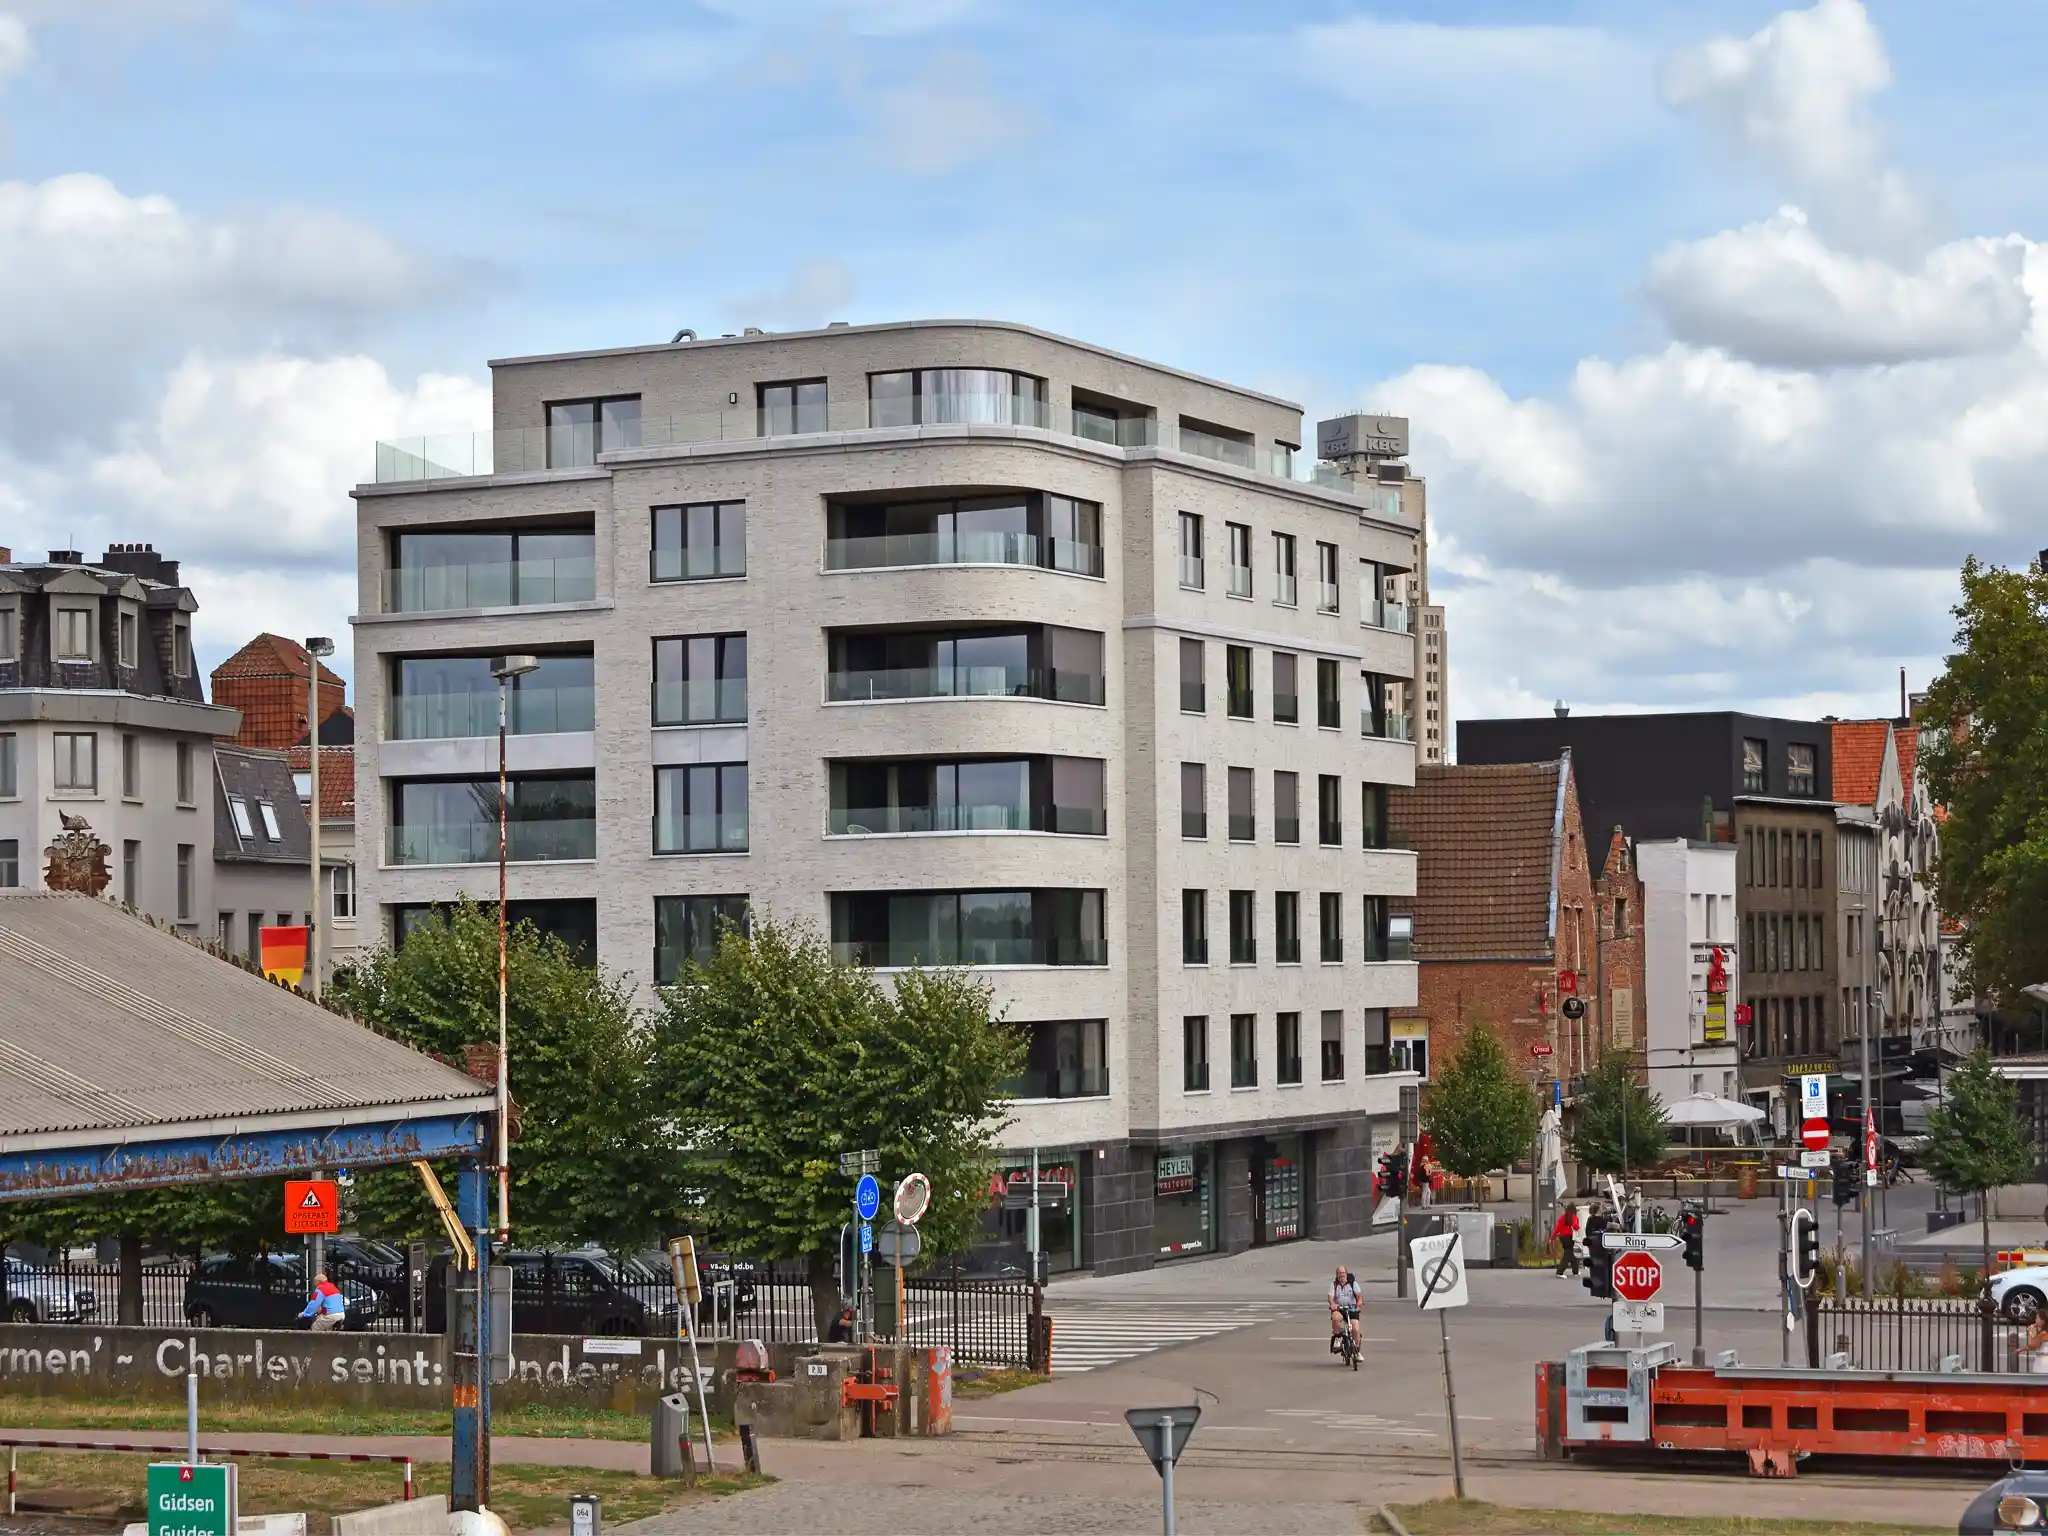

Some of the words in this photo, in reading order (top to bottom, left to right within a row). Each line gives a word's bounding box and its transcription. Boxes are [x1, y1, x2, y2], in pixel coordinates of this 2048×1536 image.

[1367, 438, 1399, 452] KBC
[1160, 1159, 1192, 1177] HEYLEN
[292, 1212, 329, 1220] OPGEPAST
[294, 1220, 329, 1228] FIETSERS
[1625, 1236, 1646, 1248] Ring
[1615, 1265, 1659, 1287] STOP
[156, 1336, 311, 1389] Charley
[332, 1345, 442, 1386] seint:
[183, 1469, 191, 1479] A
[160, 1493, 214, 1512] Gidsen
[576, 1508, 589, 1517] 064
